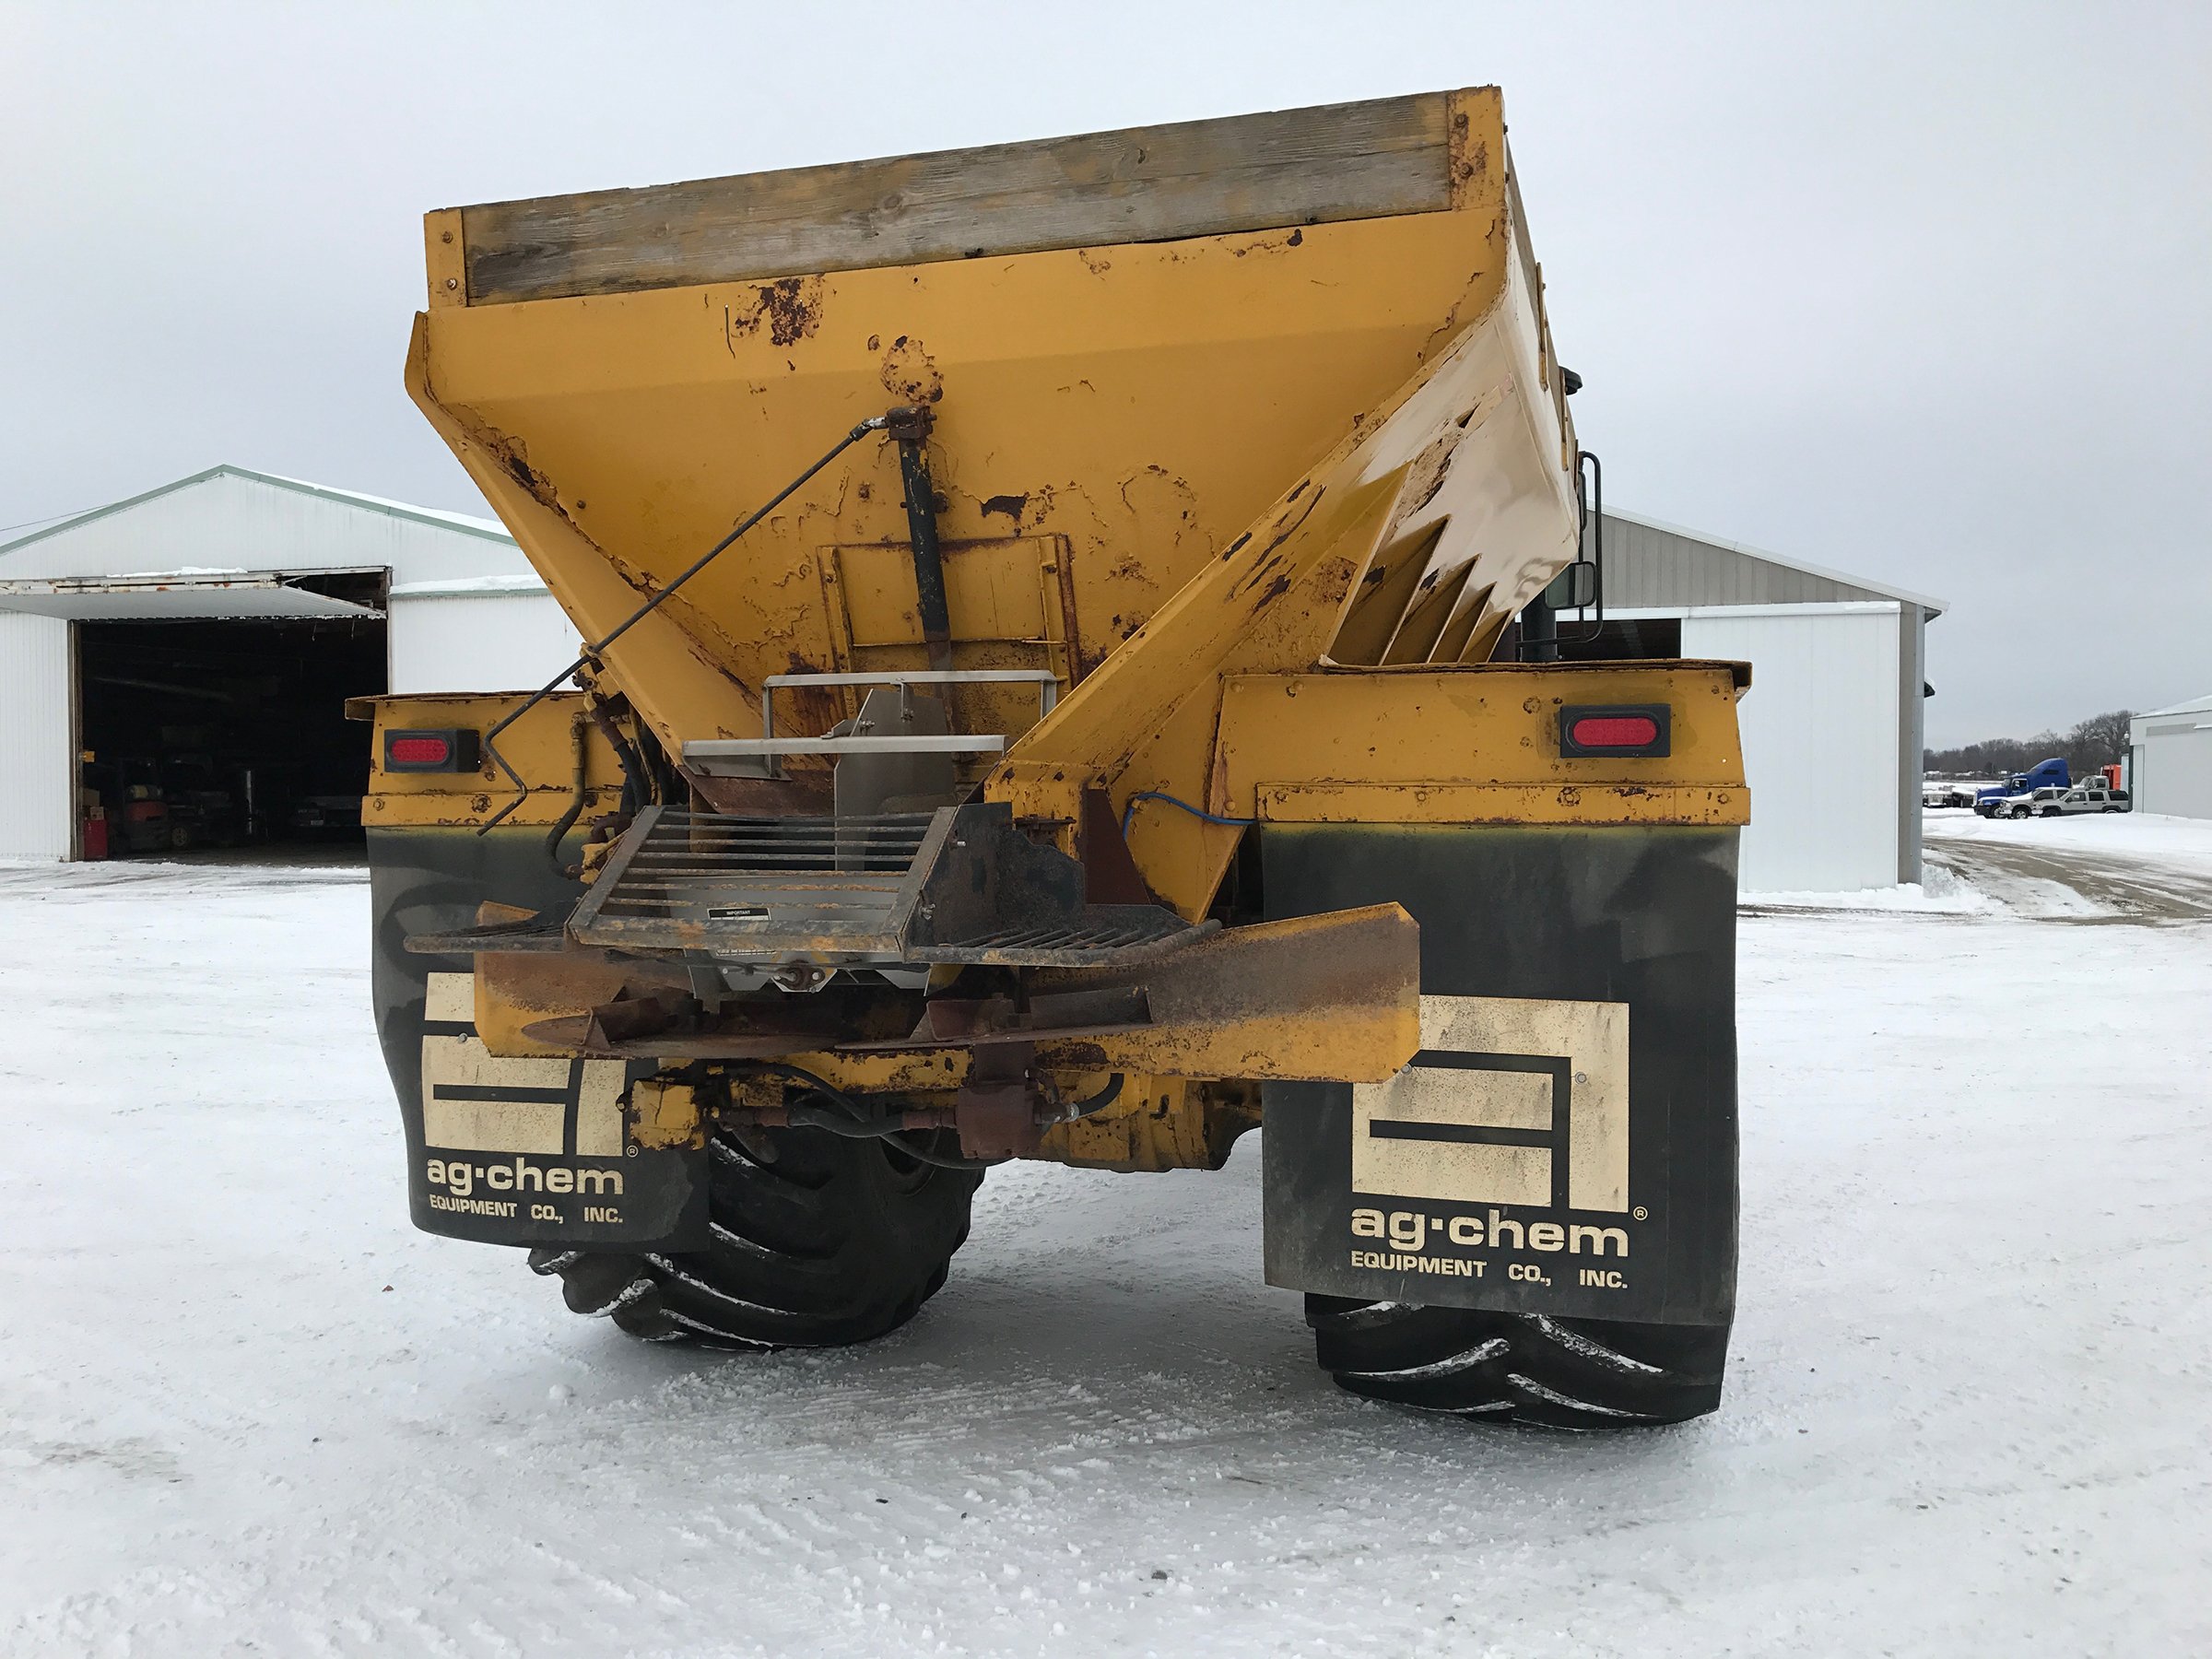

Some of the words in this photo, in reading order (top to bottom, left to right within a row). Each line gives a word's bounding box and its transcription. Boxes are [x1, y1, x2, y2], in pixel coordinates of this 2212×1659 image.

[429, 1194, 518, 1218] EQUIPMENT
[530, 1204, 563, 1224] CO.,
[583, 1206, 623, 1223] INC.
[1351, 1251, 1487, 1278] EQUIPMENT
[1508, 1263, 1551, 1287] CO.,
[1579, 1268, 1629, 1288] INC.
